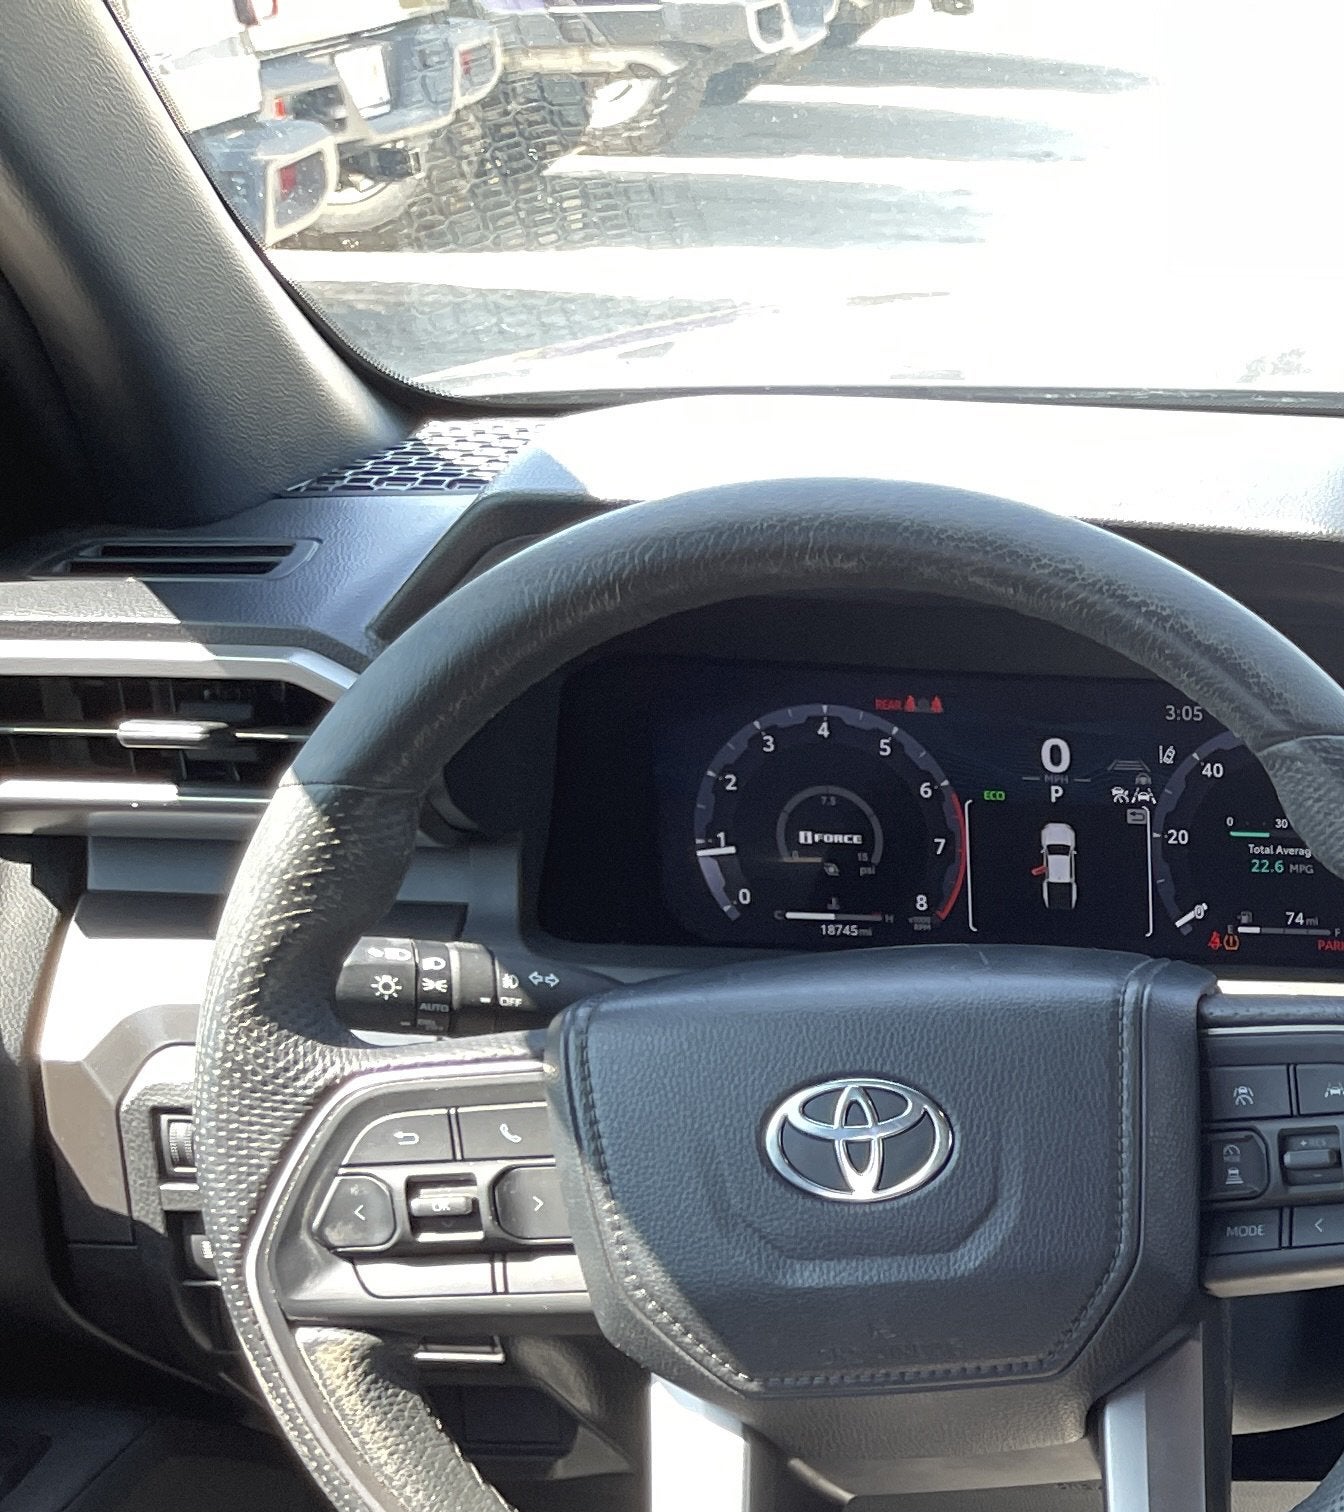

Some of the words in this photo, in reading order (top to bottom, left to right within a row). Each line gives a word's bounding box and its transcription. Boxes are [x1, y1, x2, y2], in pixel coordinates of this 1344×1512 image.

[1165, 705, 1203, 721] 3:05
[817, 721, 830, 738] 4
[762, 735, 775, 752] 3
[879, 738, 891, 756] 5
[1041, 737, 1071, 774] 0
[1202, 762, 1224, 778] 40
[725, 774, 737, 791] 2
[919, 782, 932, 799] 6
[983, 790, 1005, 801] ECO
[1051, 786, 1063, 802] P
[1226, 816, 1234, 827] 0
[1275, 818, 1288, 829] 30
[716, 832, 726, 847] 1
[1168, 829, 1189, 845] 20
[934, 838, 946, 855] 7
[1248, 843, 1274, 855] Total
[1275, 844, 1312, 858] Averag
[1251, 859, 1284, 873] 22.6
[1289, 864, 1314, 874] MPG
[738, 888, 751, 904] 0
[915, 895, 928, 911] 8
[1285, 912, 1304, 926] 74
[1305, 917, 1319, 926] mi
[820, 924, 859, 936] 18745
[420, 1003, 449, 1013] AUTO
[499, 996, 522, 1007] OFF
[1226, 1224, 1265, 1237] MODE
